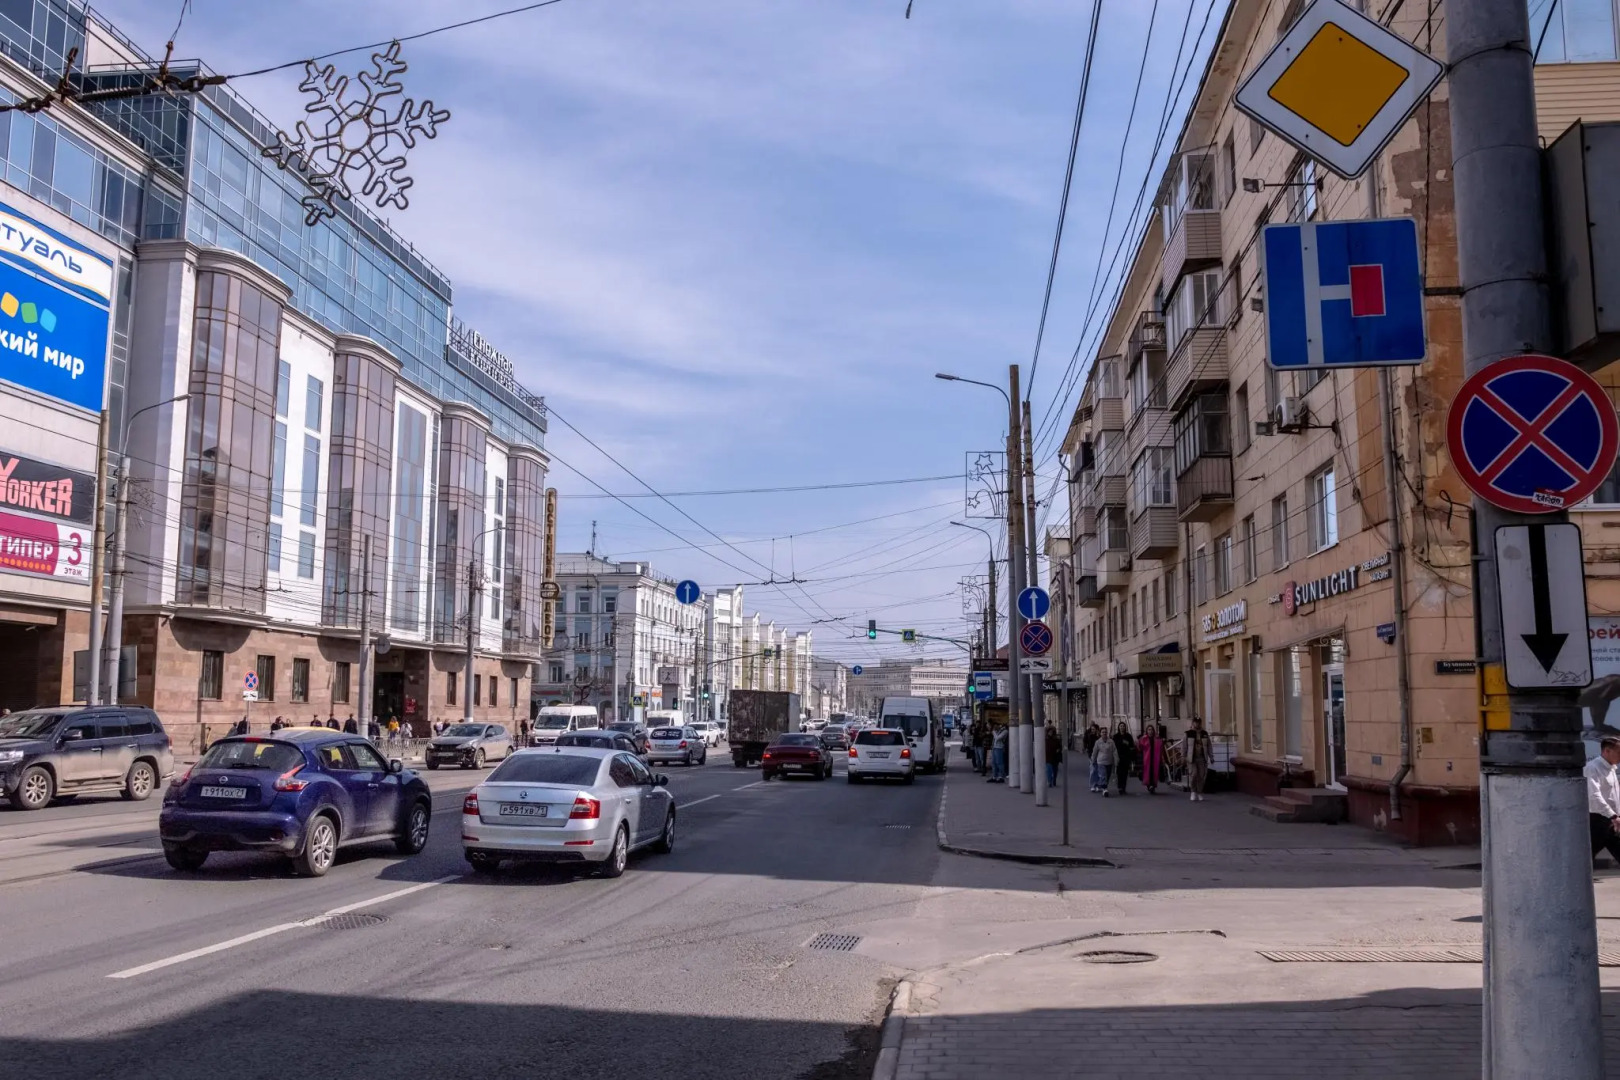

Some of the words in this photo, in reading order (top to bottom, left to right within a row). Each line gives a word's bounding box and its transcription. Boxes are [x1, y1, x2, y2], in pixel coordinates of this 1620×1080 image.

[0, 222, 83, 274] туаль
[43, 345, 85, 380] мир
[67, 532, 83, 566] 3
[1295, 565, 1357, 606] SUNLIGHT
